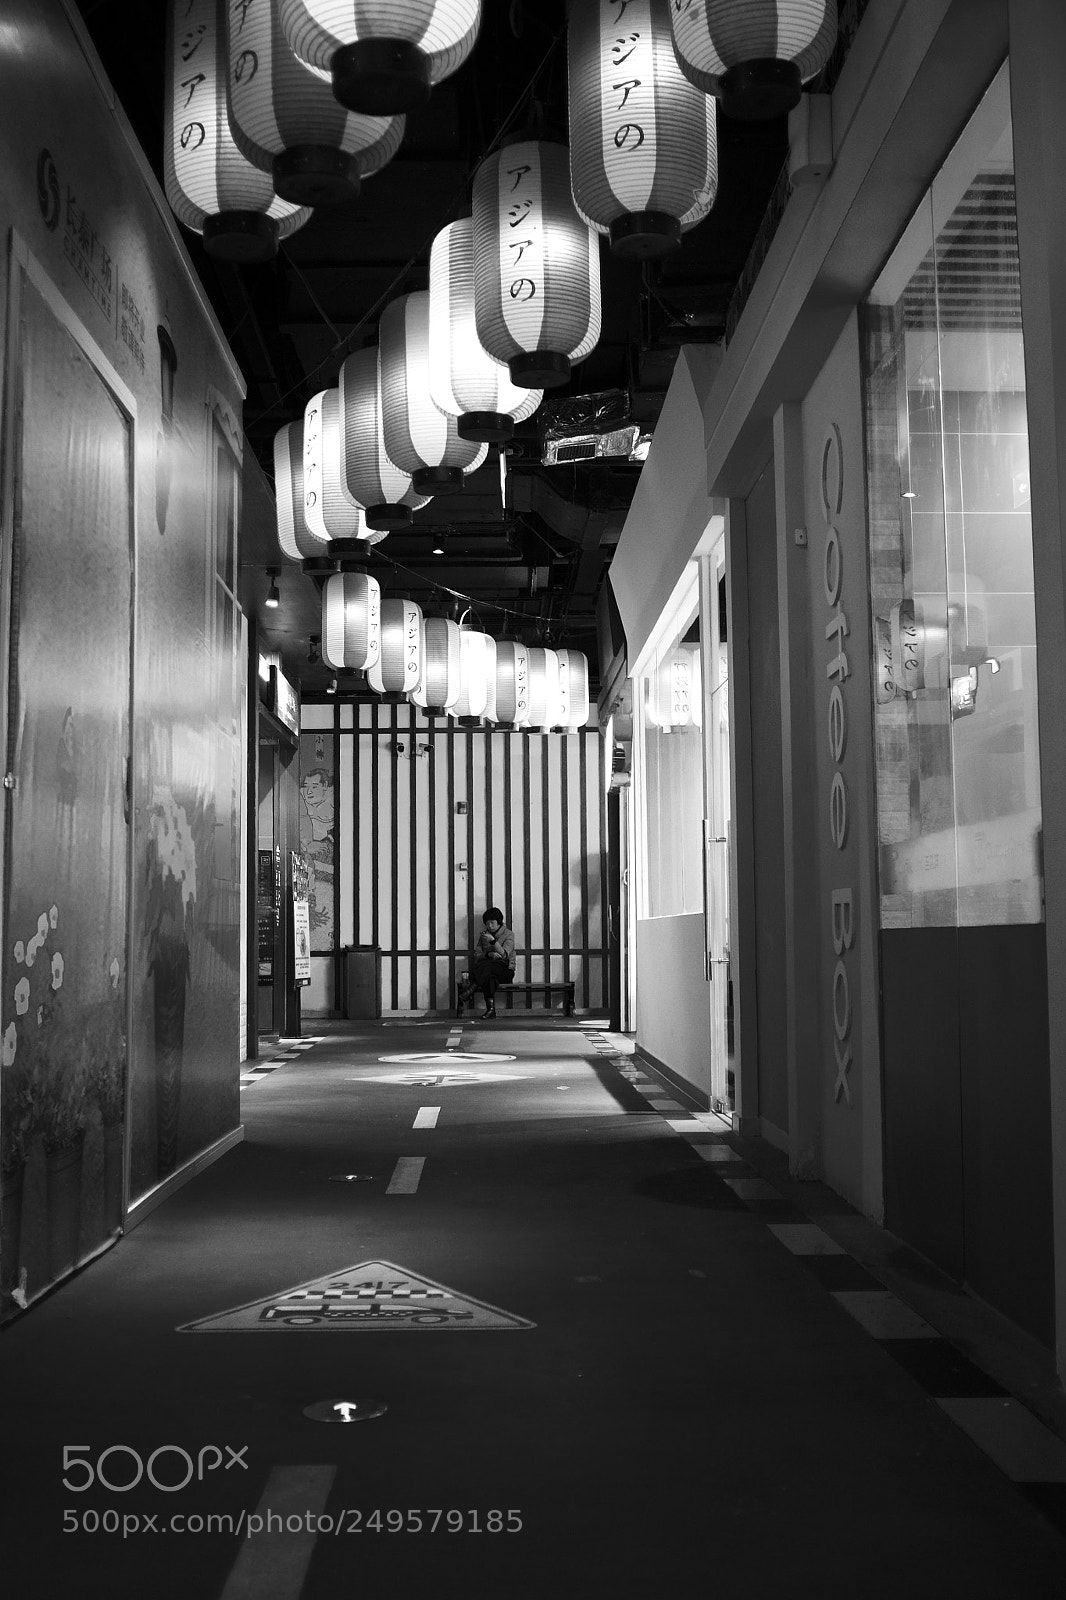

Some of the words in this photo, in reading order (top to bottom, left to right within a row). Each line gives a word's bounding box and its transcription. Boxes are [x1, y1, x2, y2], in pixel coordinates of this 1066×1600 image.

[507, 165, 536, 302] アジアの
[407, 612, 418, 673] アジアの
[517, 656, 527, 710] アジアの
